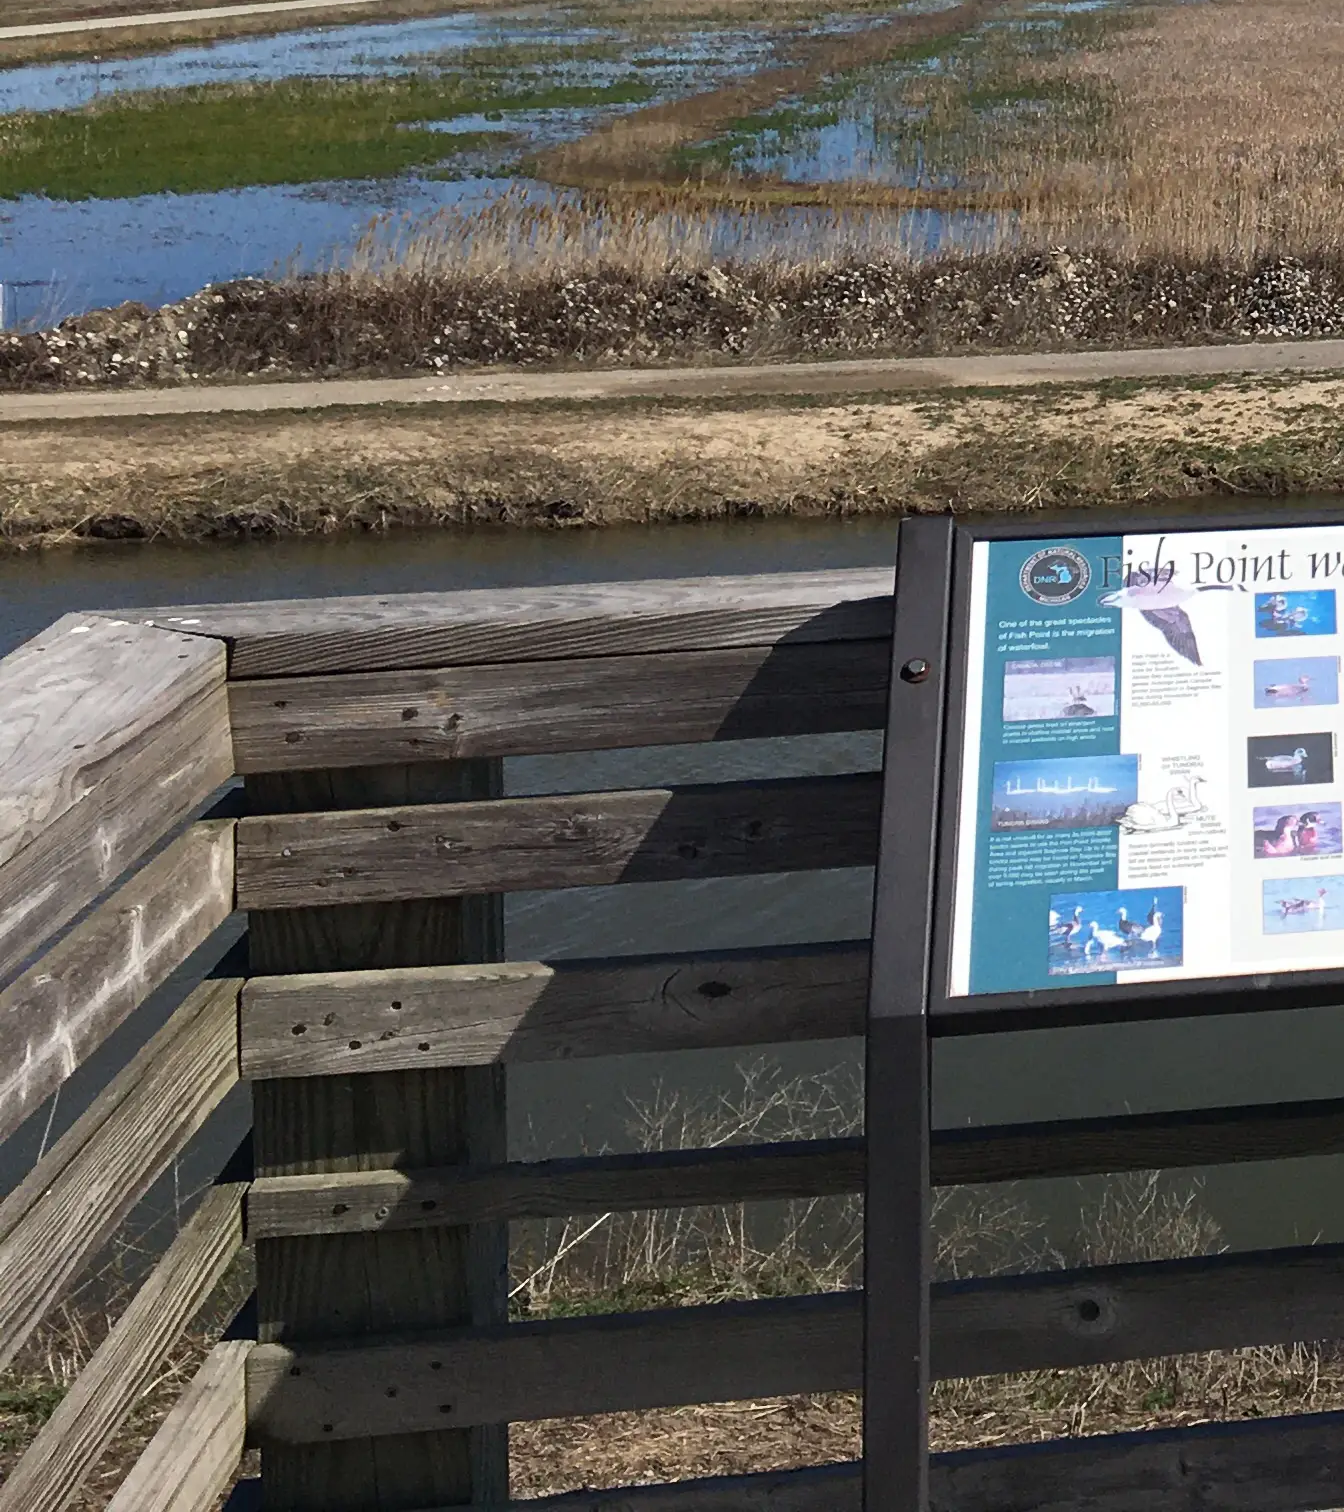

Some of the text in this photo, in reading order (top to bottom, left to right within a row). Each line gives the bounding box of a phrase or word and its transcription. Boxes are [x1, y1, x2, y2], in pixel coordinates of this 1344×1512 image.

[1100, 536, 1176, 594] Fish
[1191, 544, 1293, 585] Point
[1033, 575, 1057, 584] DNR
[999, 620, 1017, 628] One
[1018, 620, 1028, 628] of
[1029, 619, 1042, 627] the
[1044, 618, 1066, 628] great
[998, 628, 1115, 640] of Fish Point is the migration
[997, 644, 1007, 652] of
